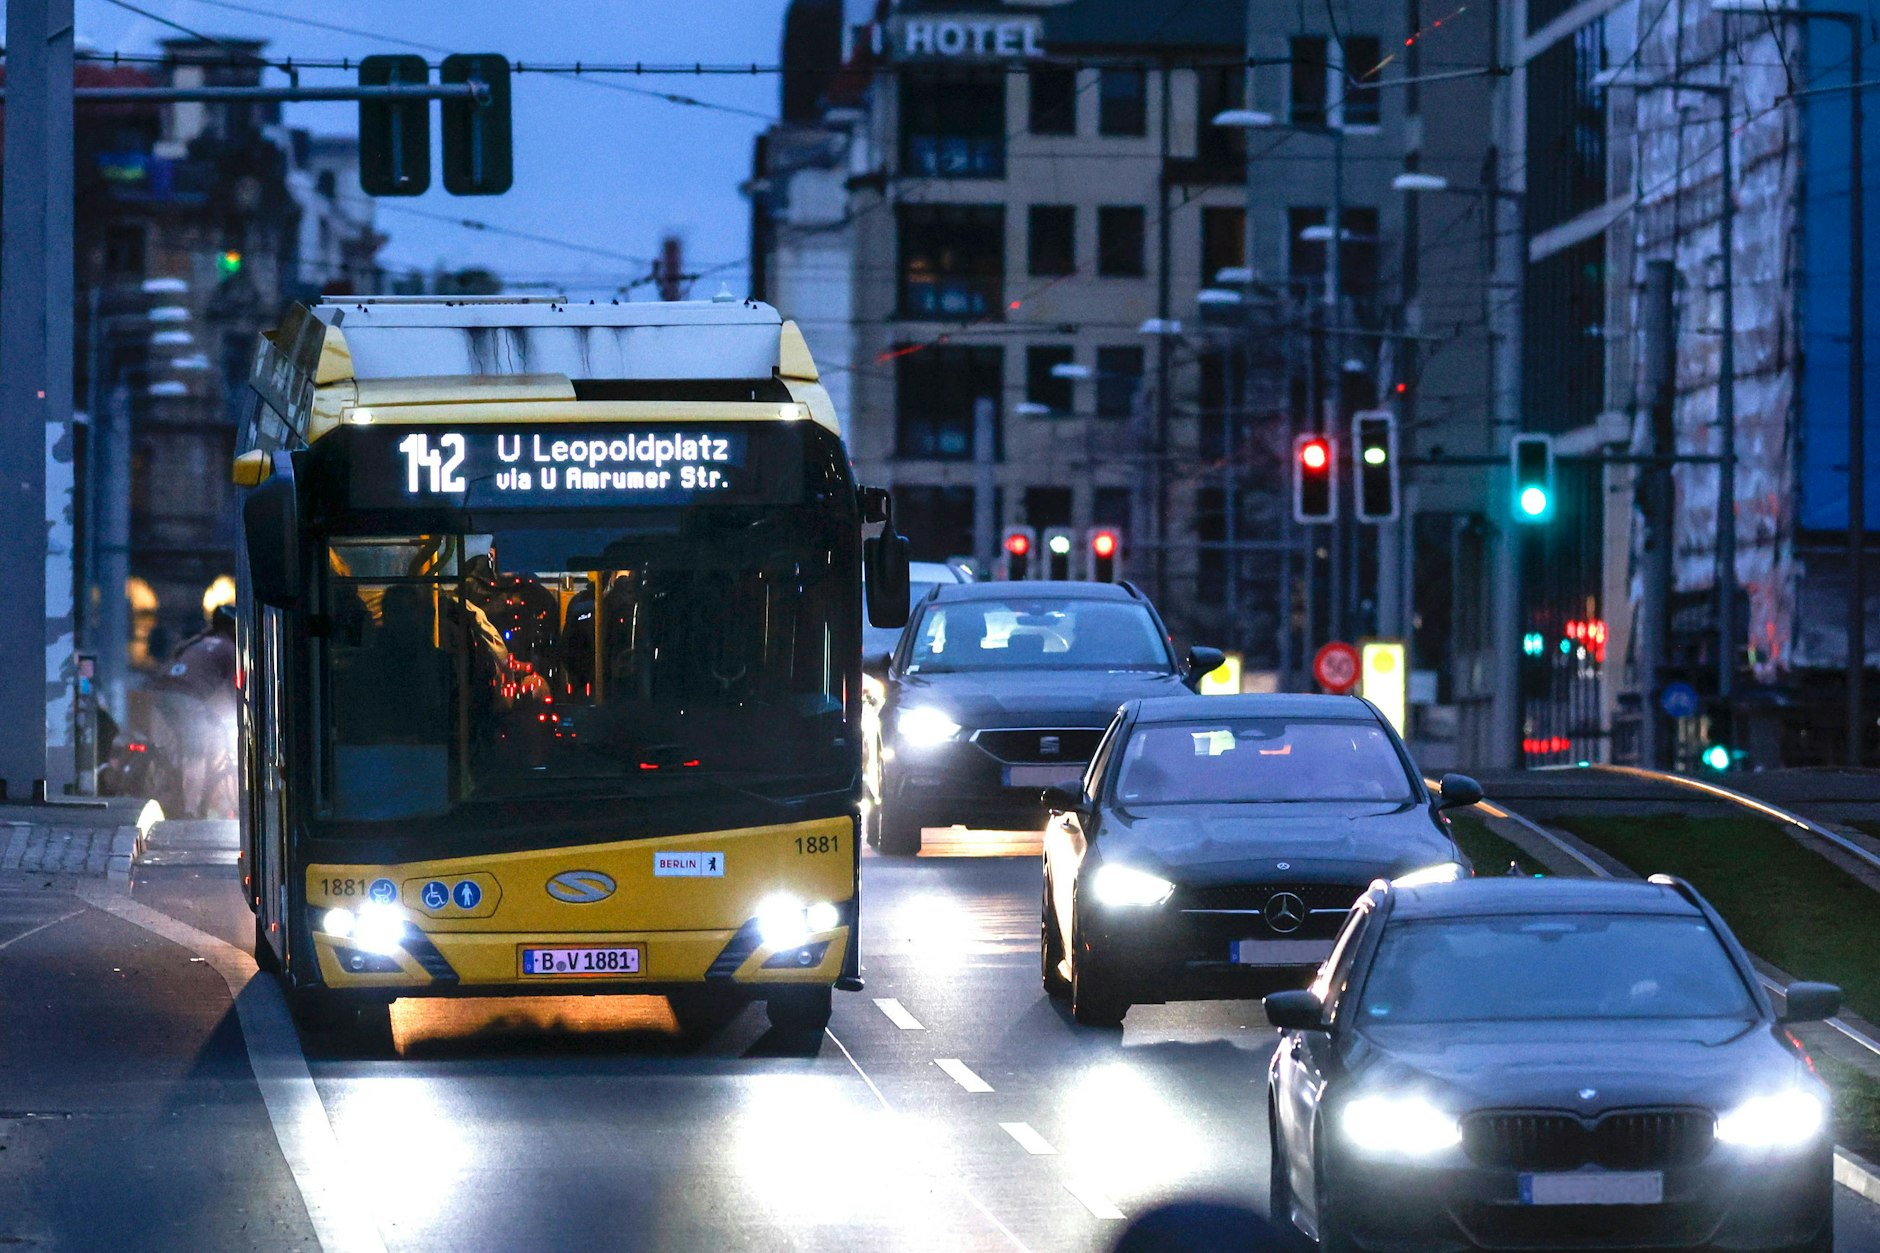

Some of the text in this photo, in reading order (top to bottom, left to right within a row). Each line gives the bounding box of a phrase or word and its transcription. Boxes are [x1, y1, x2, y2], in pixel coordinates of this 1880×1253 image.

[905, 21, 1044, 56] HOTEL
[498, 433, 728, 468] U Leopoldplatz
[399, 433, 465, 493] 142
[496, 465, 728, 490] via U Amrumer Str.
[794, 835, 839, 855] 1881
[659, 859, 696, 869] BERLIN
[321, 878, 366, 896] 1881
[542, 952, 554, 971] B
[567, 952, 579, 970] V
[584, 951, 630, 970] 1881
